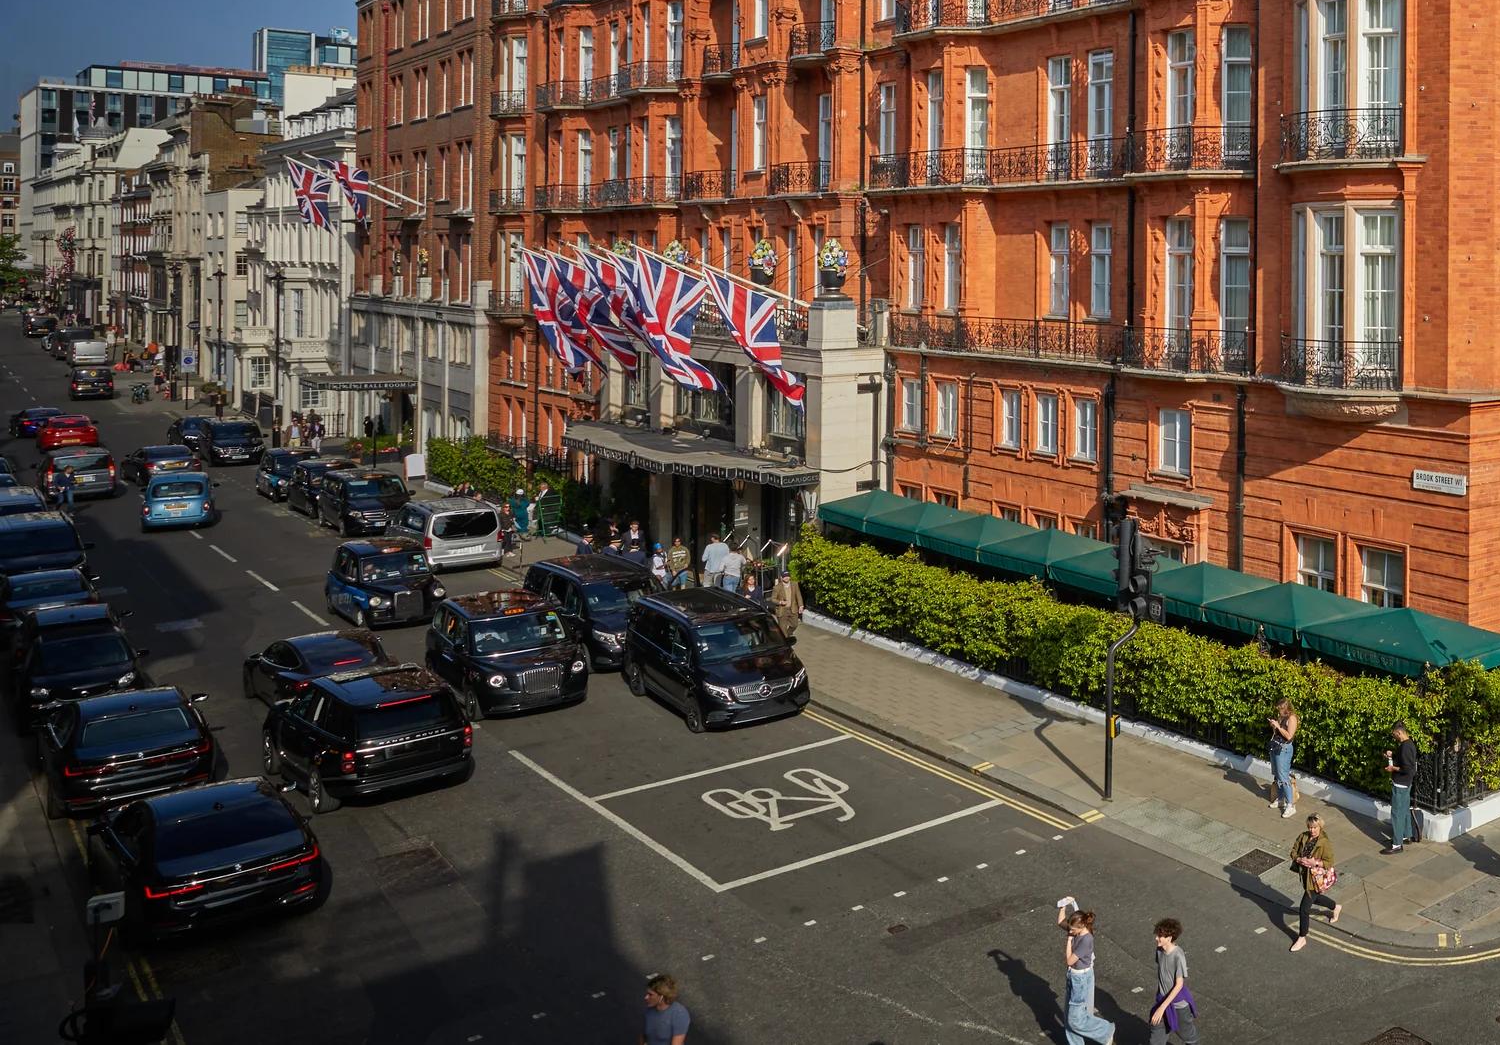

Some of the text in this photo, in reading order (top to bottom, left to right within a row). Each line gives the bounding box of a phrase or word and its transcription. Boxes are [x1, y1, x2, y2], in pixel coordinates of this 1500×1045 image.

[1416, 473, 1463, 486] BROOK STREET W1
[379, 728, 447, 746] RANGE ROVER
